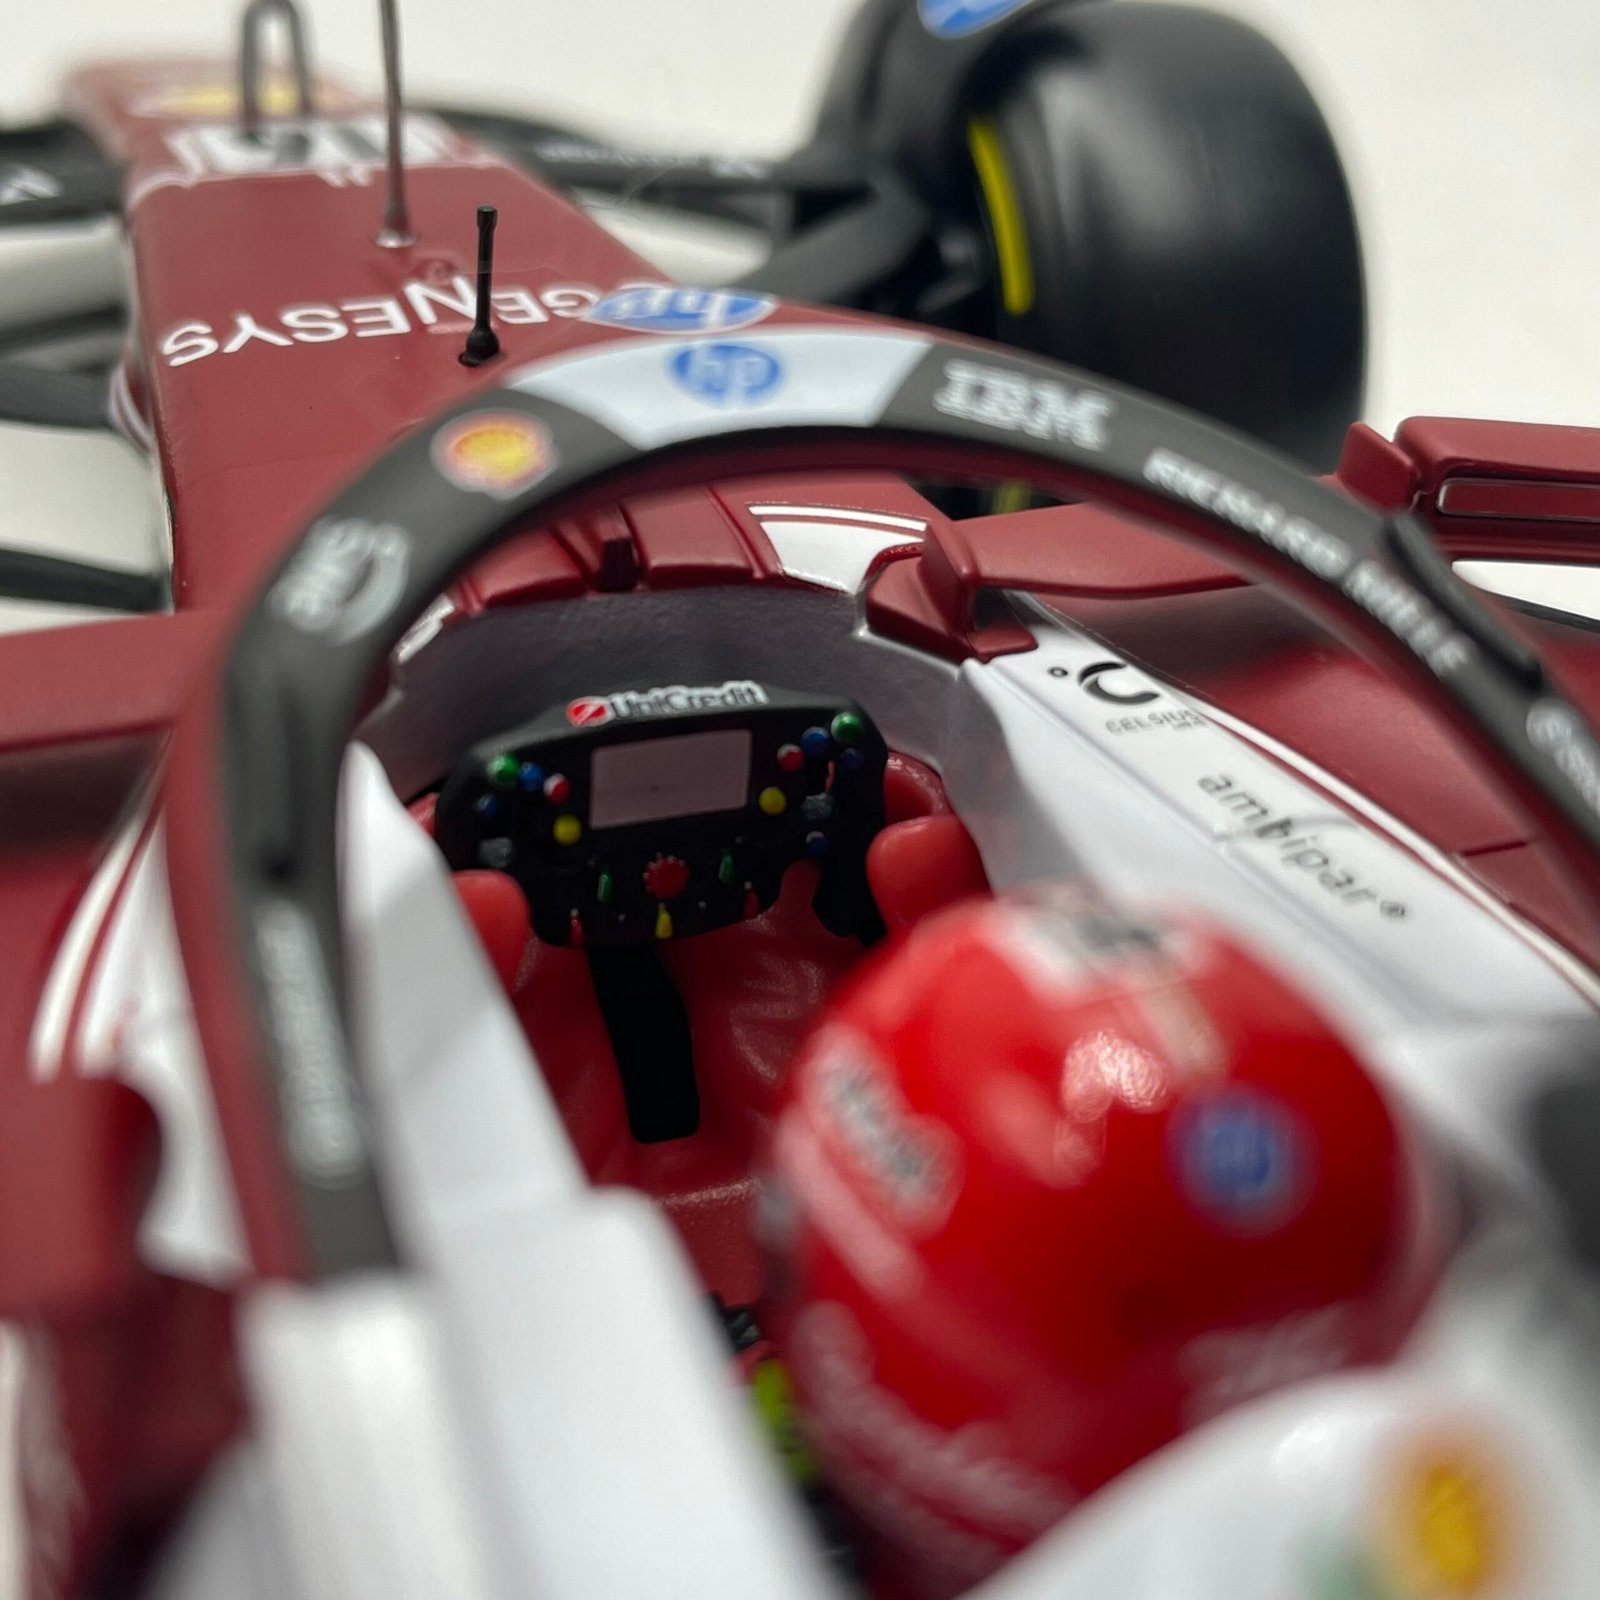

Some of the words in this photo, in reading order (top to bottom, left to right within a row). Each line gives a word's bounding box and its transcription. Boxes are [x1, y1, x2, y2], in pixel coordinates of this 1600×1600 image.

[161, 273, 600, 367] GENESYS
[682, 339, 774, 410] hp
[933, 359, 1112, 451] IBM
[608, 679, 768, 719] UniCredit
[1105, 708, 1203, 735] CELSIUS
